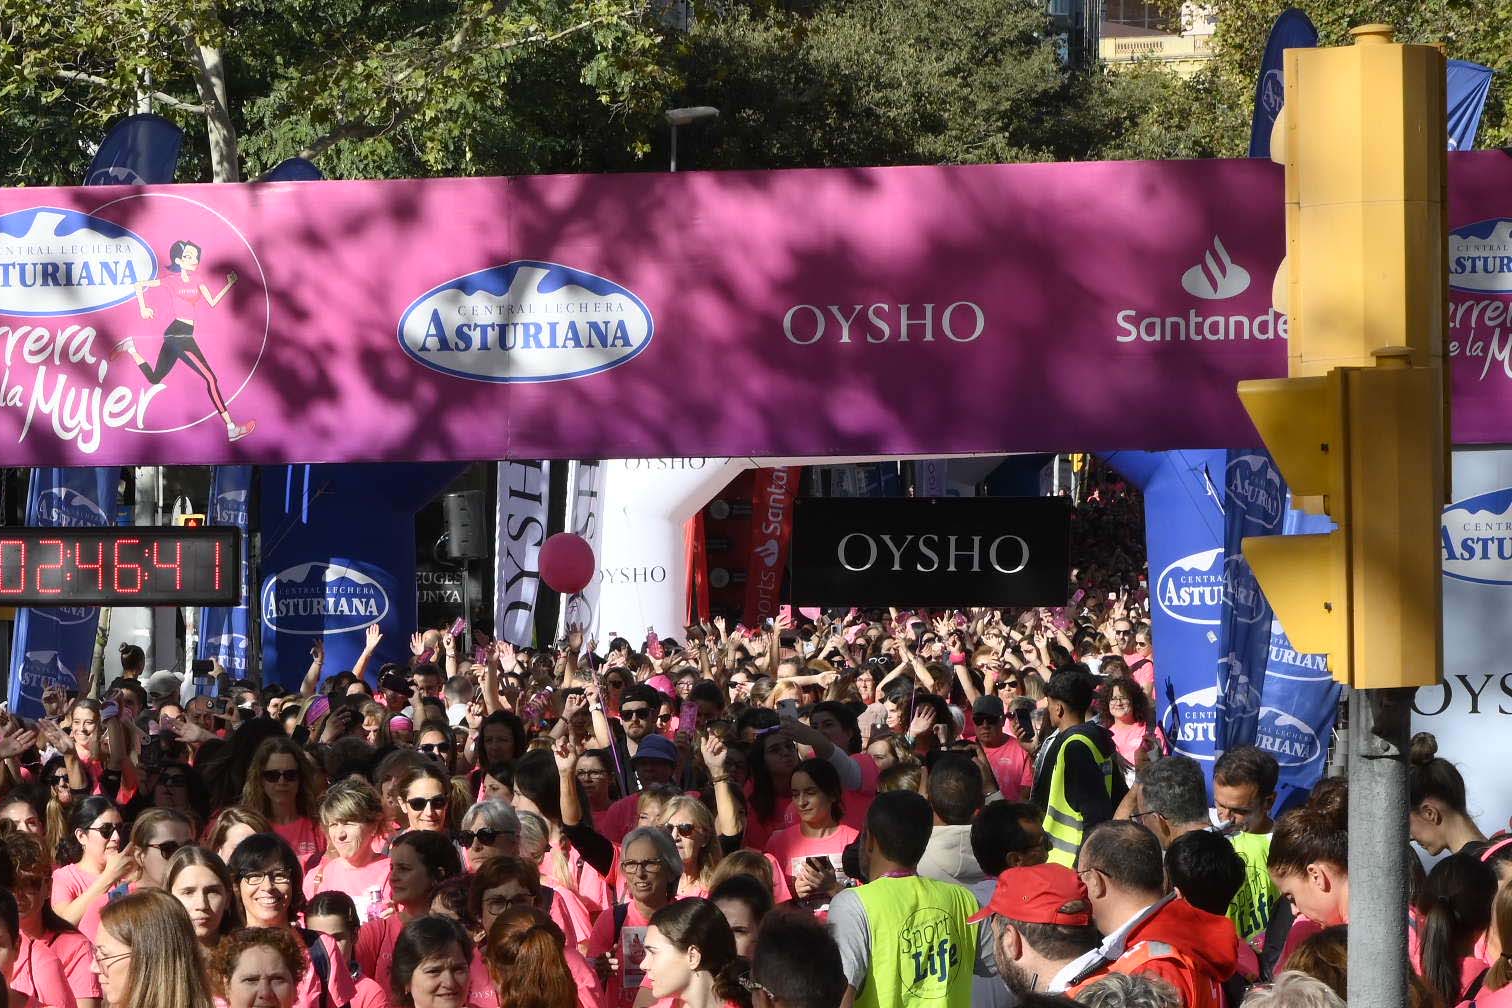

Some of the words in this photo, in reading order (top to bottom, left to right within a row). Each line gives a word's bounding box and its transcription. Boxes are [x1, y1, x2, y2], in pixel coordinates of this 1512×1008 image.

[60, 244, 133, 256] LECHERA
[457, 303, 536, 317] CENTRAL
[544, 300, 625, 315] LECHERA
[783, 301, 986, 345] OYSHO
[1115, 309, 1288, 343] Santande
[418, 308, 634, 353] ASTURIANA
[0, 368, 24, 408] la
[19, 359, 168, 454] Mujer
[1463, 521, 1512, 532] CENTR
[838, 533, 1030, 574] OYSHO
[1181, 575, 1224, 583] CENTRA
[266, 591, 379, 619] ASTURIANA
[902, 914, 951, 954] Sport
[912, 938, 959, 984] Life
